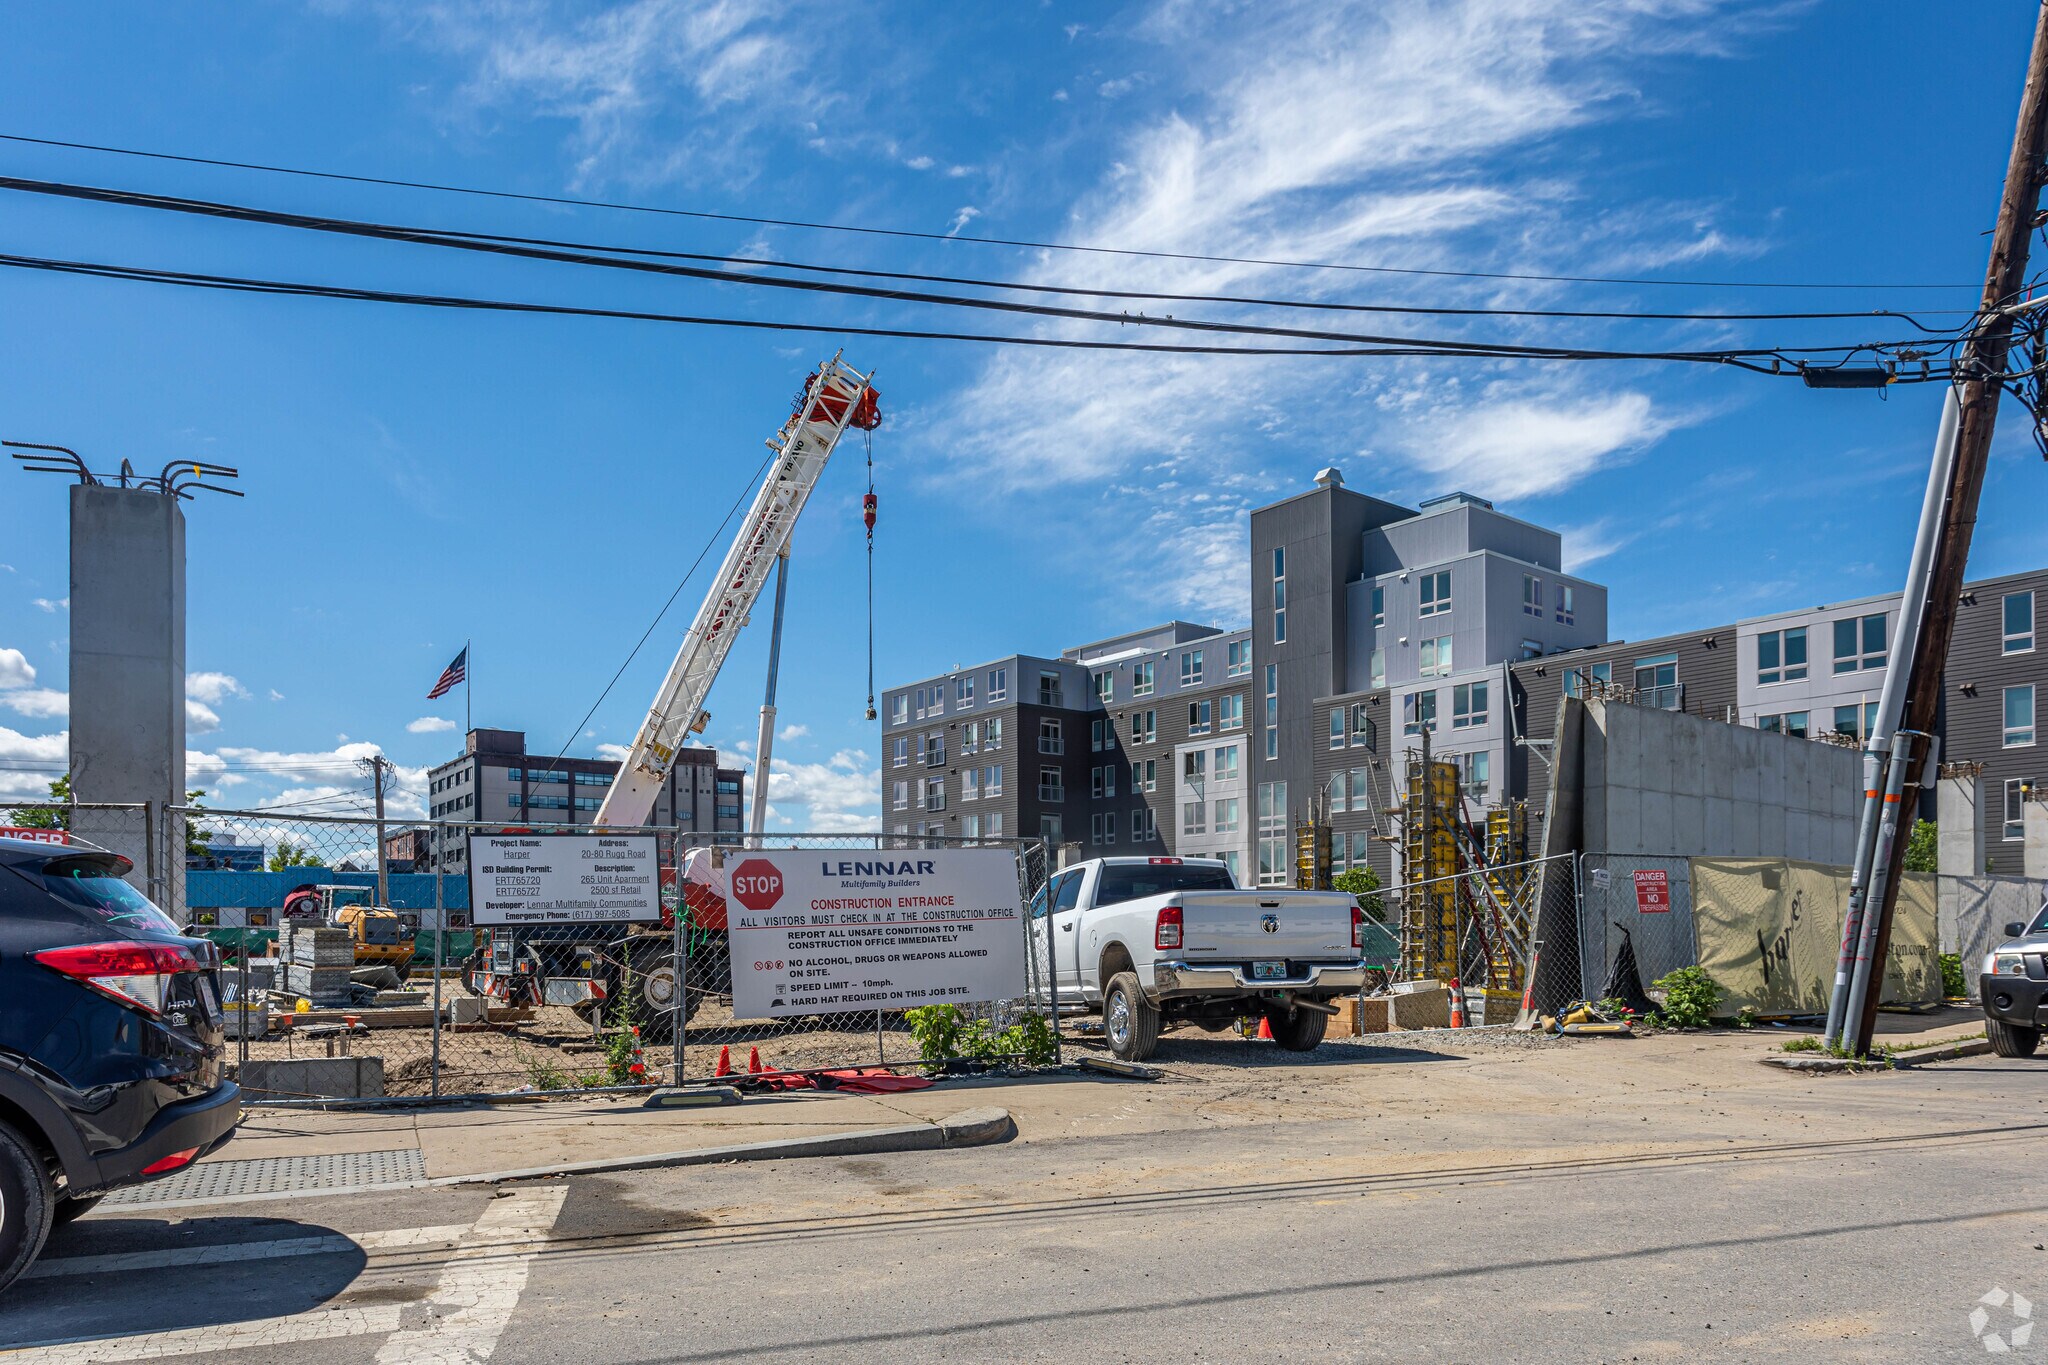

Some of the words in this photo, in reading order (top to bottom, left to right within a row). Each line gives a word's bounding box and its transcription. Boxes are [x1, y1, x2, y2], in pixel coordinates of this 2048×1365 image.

[491, 840, 517, 848] Project
[504, 851, 530, 859] Harper
[605, 850, 625, 859] Rugg
[628, 850, 646, 858] Road
[496, 865, 524, 874] Building
[594, 865, 635, 873] Description:
[822, 860, 936, 876] LENNAR
[495, 876, 540, 885] ERT765720
[581, 875, 595, 883] 265
[614, 875, 649, 884] Aparment
[1636, 872, 1665, 881] DANGER
[736, 876, 780, 894] STOP
[840, 880, 886, 889] Multifamily
[888, 879, 920, 888] Builders
[496, 887, 540, 896] ERT765727
[591, 886, 609, 894] 2500
[811, 898, 892, 910] CONSTRUCTION
[898, 896, 954, 908] ENTRANCE
[1647, 894, 1658, 903] NO
[485, 902, 524, 910] Developer:
[527, 900, 553, 909] Lennar
[556, 900, 598, 908] Multifamily
[600, 899, 647, 907] Communities
[505, 912, 544, 921] Emergency
[572, 911, 593, 919] (617)
[595, 910, 630, 918] 997-5085
[740, 918, 757, 927] ALL
[764, 916, 806, 926] VISITORS
[812, 915, 835, 924] MUST
[841, 914, 867, 924] CHECK
[873, 913, 881, 922] IN
[886, 913, 896, 922] AT
[902, 912, 918, 921] THE
[923, 908, 984, 920] CONSTRUCTION
[988, 908, 1013, 918] OFFICE
[788, 930, 826, 940] REPORT
[828, 928, 845, 938] ALL
[848, 927, 883, 937] UNSAFE
[886, 925, 940, 935] CONDITIONS
[943, 925, 955, 934] TO
[957, 924, 974, 933] THE
[788, 939, 862, 950] CONSTRUCTION
[865, 937, 896, 946] OFFICE
[898, 934, 958, 944] IMMEDIATELY
[789, 959, 802, 968] NO
[806, 956, 852, 966] ALCOHOL,
[855, 954, 885, 963] DRUGS
[888, 953, 900, 962] OR
[903, 951, 946, 961] WEAPONS
[948, 949, 988, 958] ALLOWED
[789, 970, 804, 978] ON
[806, 968, 830, 977] SITE.
[790, 982, 821, 992] SPEED
[824, 981, 849, 990] LIMIT
[862, 978, 893, 989] 10mph.
[791, 997, 818, 1006] HARD
[821, 995, 840, 1004] HAT
[842, 993, 888, 1003] REQUIRED
[890, 991, 904, 1000] ON
[906, 990, 926, 999] THIS
[928, 988, 946, 998] JOB
[948, 986, 970, 996] SITE.
[167, 999, 196, 1010] HR-V
